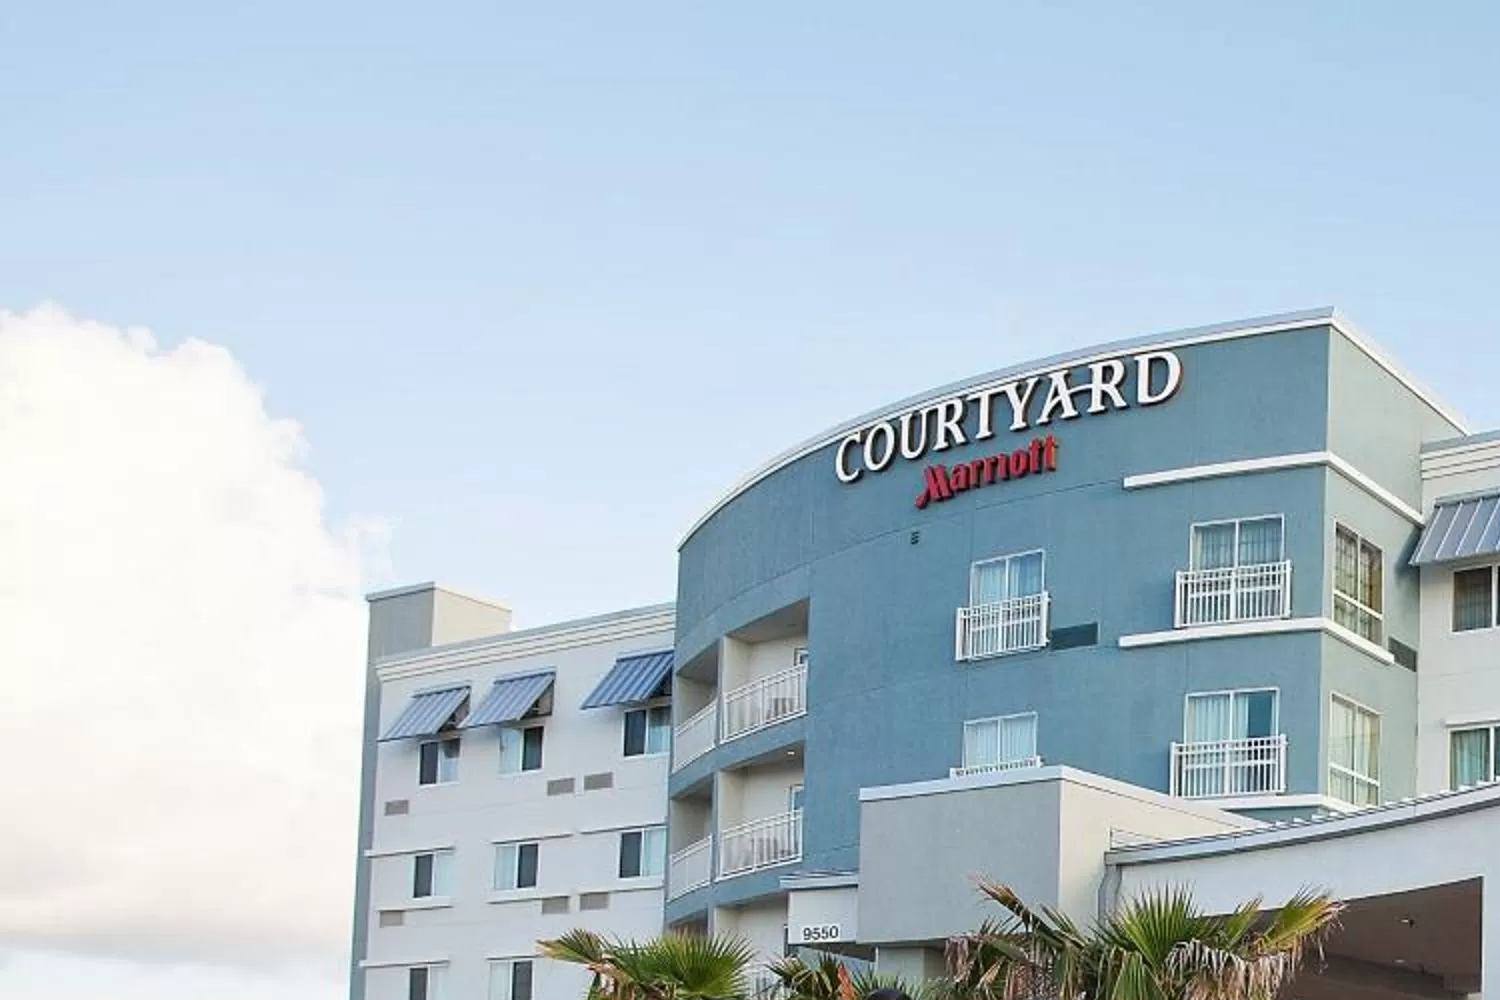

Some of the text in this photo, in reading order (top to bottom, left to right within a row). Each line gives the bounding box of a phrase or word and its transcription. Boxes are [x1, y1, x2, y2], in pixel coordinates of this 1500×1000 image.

[834, 350, 1184, 484] COURTYARD
[914, 433, 1060, 510] Marriott
[803, 925, 839, 941] 9550
